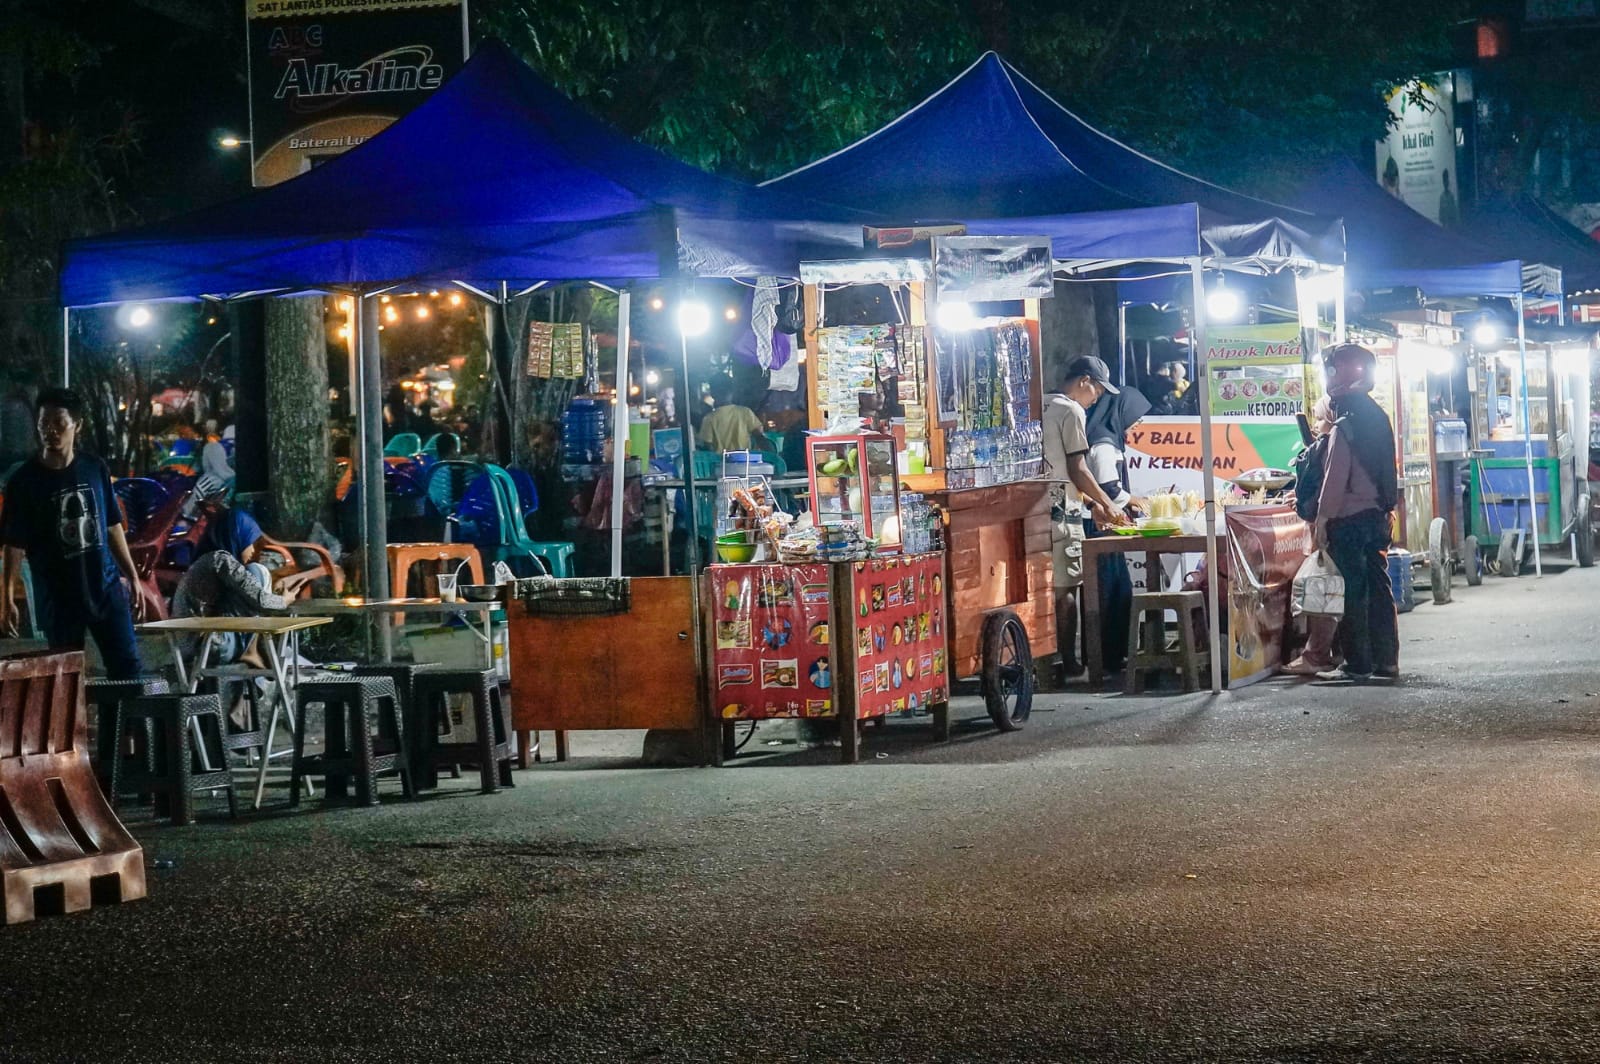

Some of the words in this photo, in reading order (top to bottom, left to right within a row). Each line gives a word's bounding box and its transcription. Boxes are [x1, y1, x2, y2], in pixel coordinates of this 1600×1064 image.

[257, 2, 278, 13] SAT
[268, 24, 322, 48] AC
[274, 58, 443, 98] Alkaline
[288, 137, 343, 149] Baterai
[1207, 346, 1257, 359] Mpok
[1150, 431, 1196, 445] BALL
[1148, 456, 1237, 469] KEKINAN
